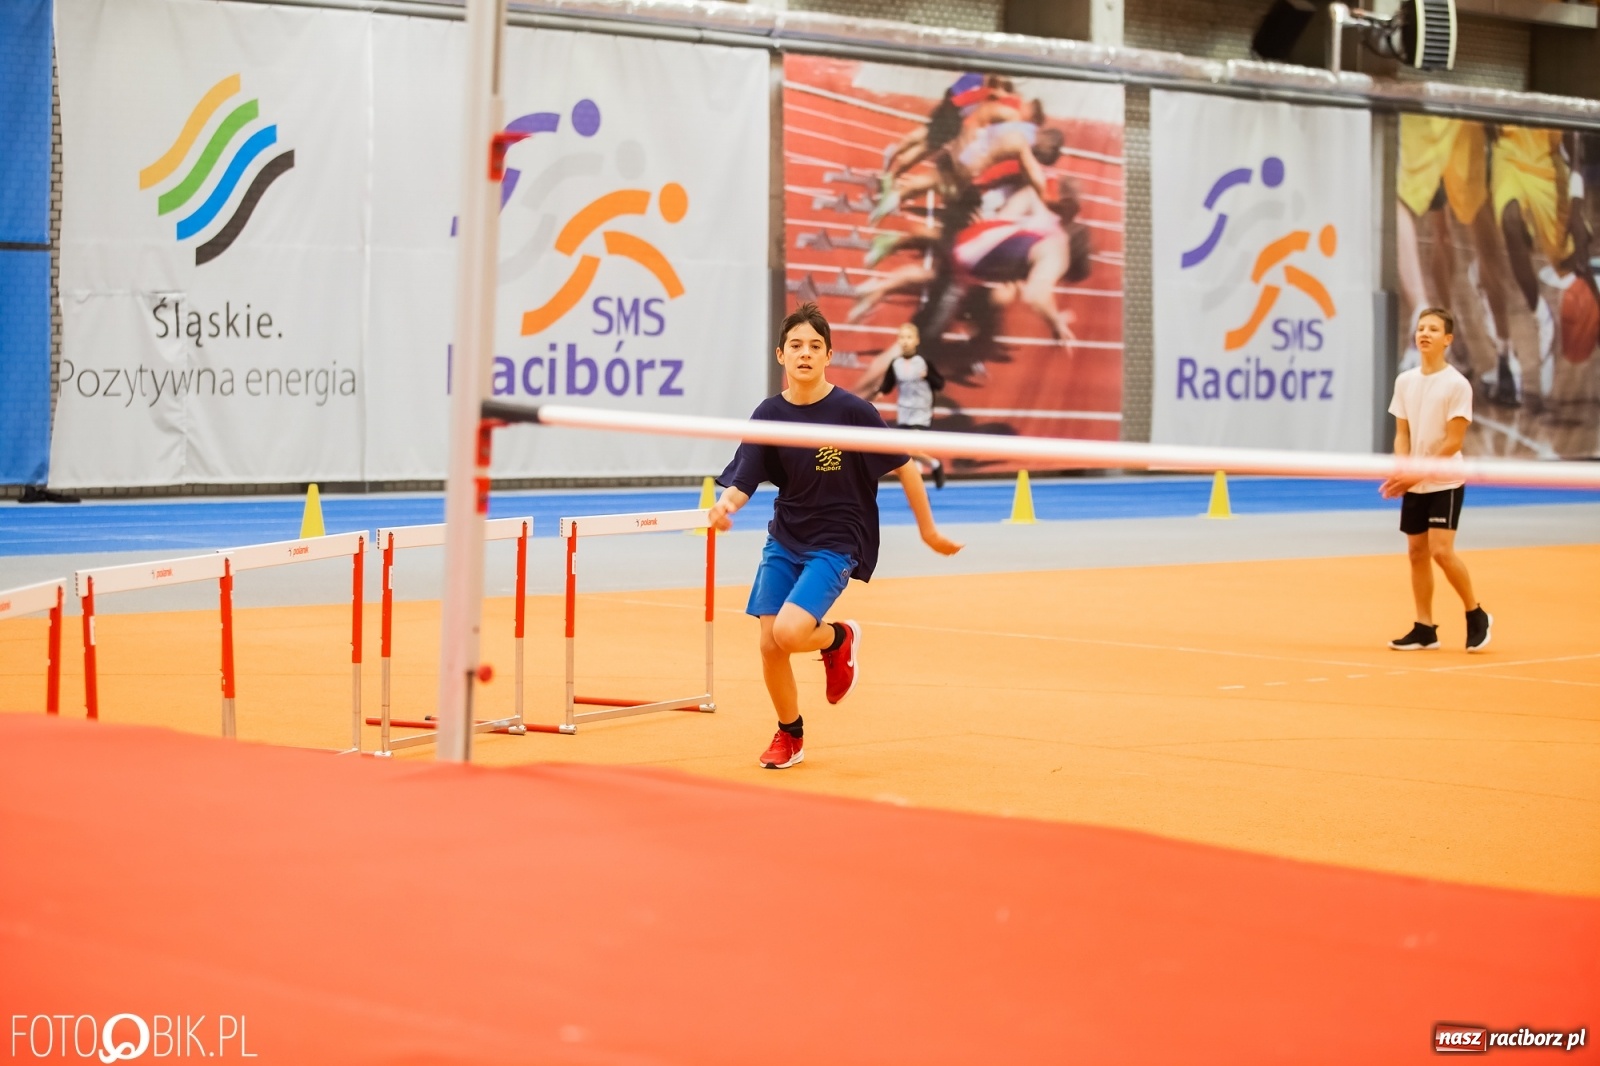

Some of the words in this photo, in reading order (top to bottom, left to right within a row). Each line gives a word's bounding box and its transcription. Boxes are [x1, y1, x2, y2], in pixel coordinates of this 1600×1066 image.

[152, 297, 283, 347] Śląskie.
[592, 296, 665, 336] SMS
[1271, 318, 1324, 351] SMS
[59, 359, 234, 408] Pozytywna
[245, 361, 356, 406] energia
[447, 340, 684, 396] acibórz
[1176, 355, 1334, 401] Racibórz
